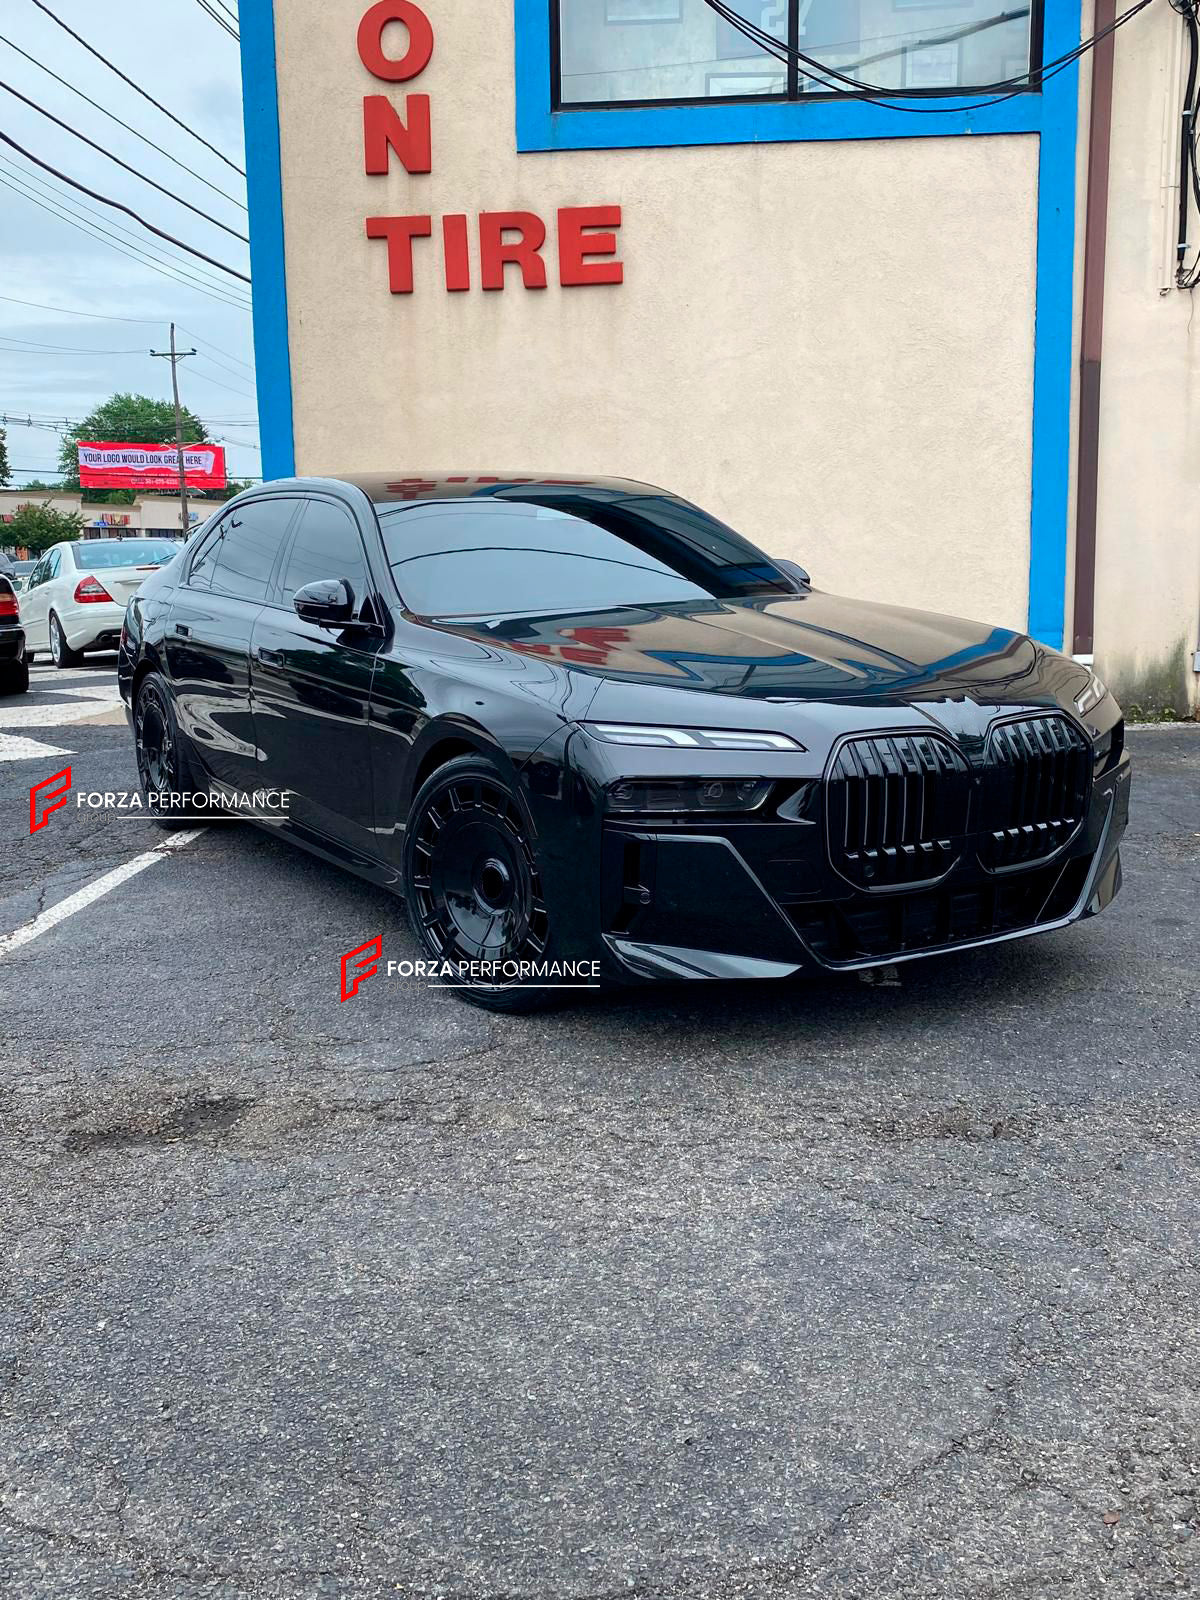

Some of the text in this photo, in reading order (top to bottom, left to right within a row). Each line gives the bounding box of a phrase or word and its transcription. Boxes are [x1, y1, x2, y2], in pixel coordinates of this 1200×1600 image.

[365, 205, 624, 295] TIRE
[84, 453, 203, 465] YOUR LOGO WOULD LOOK GREA HERE
